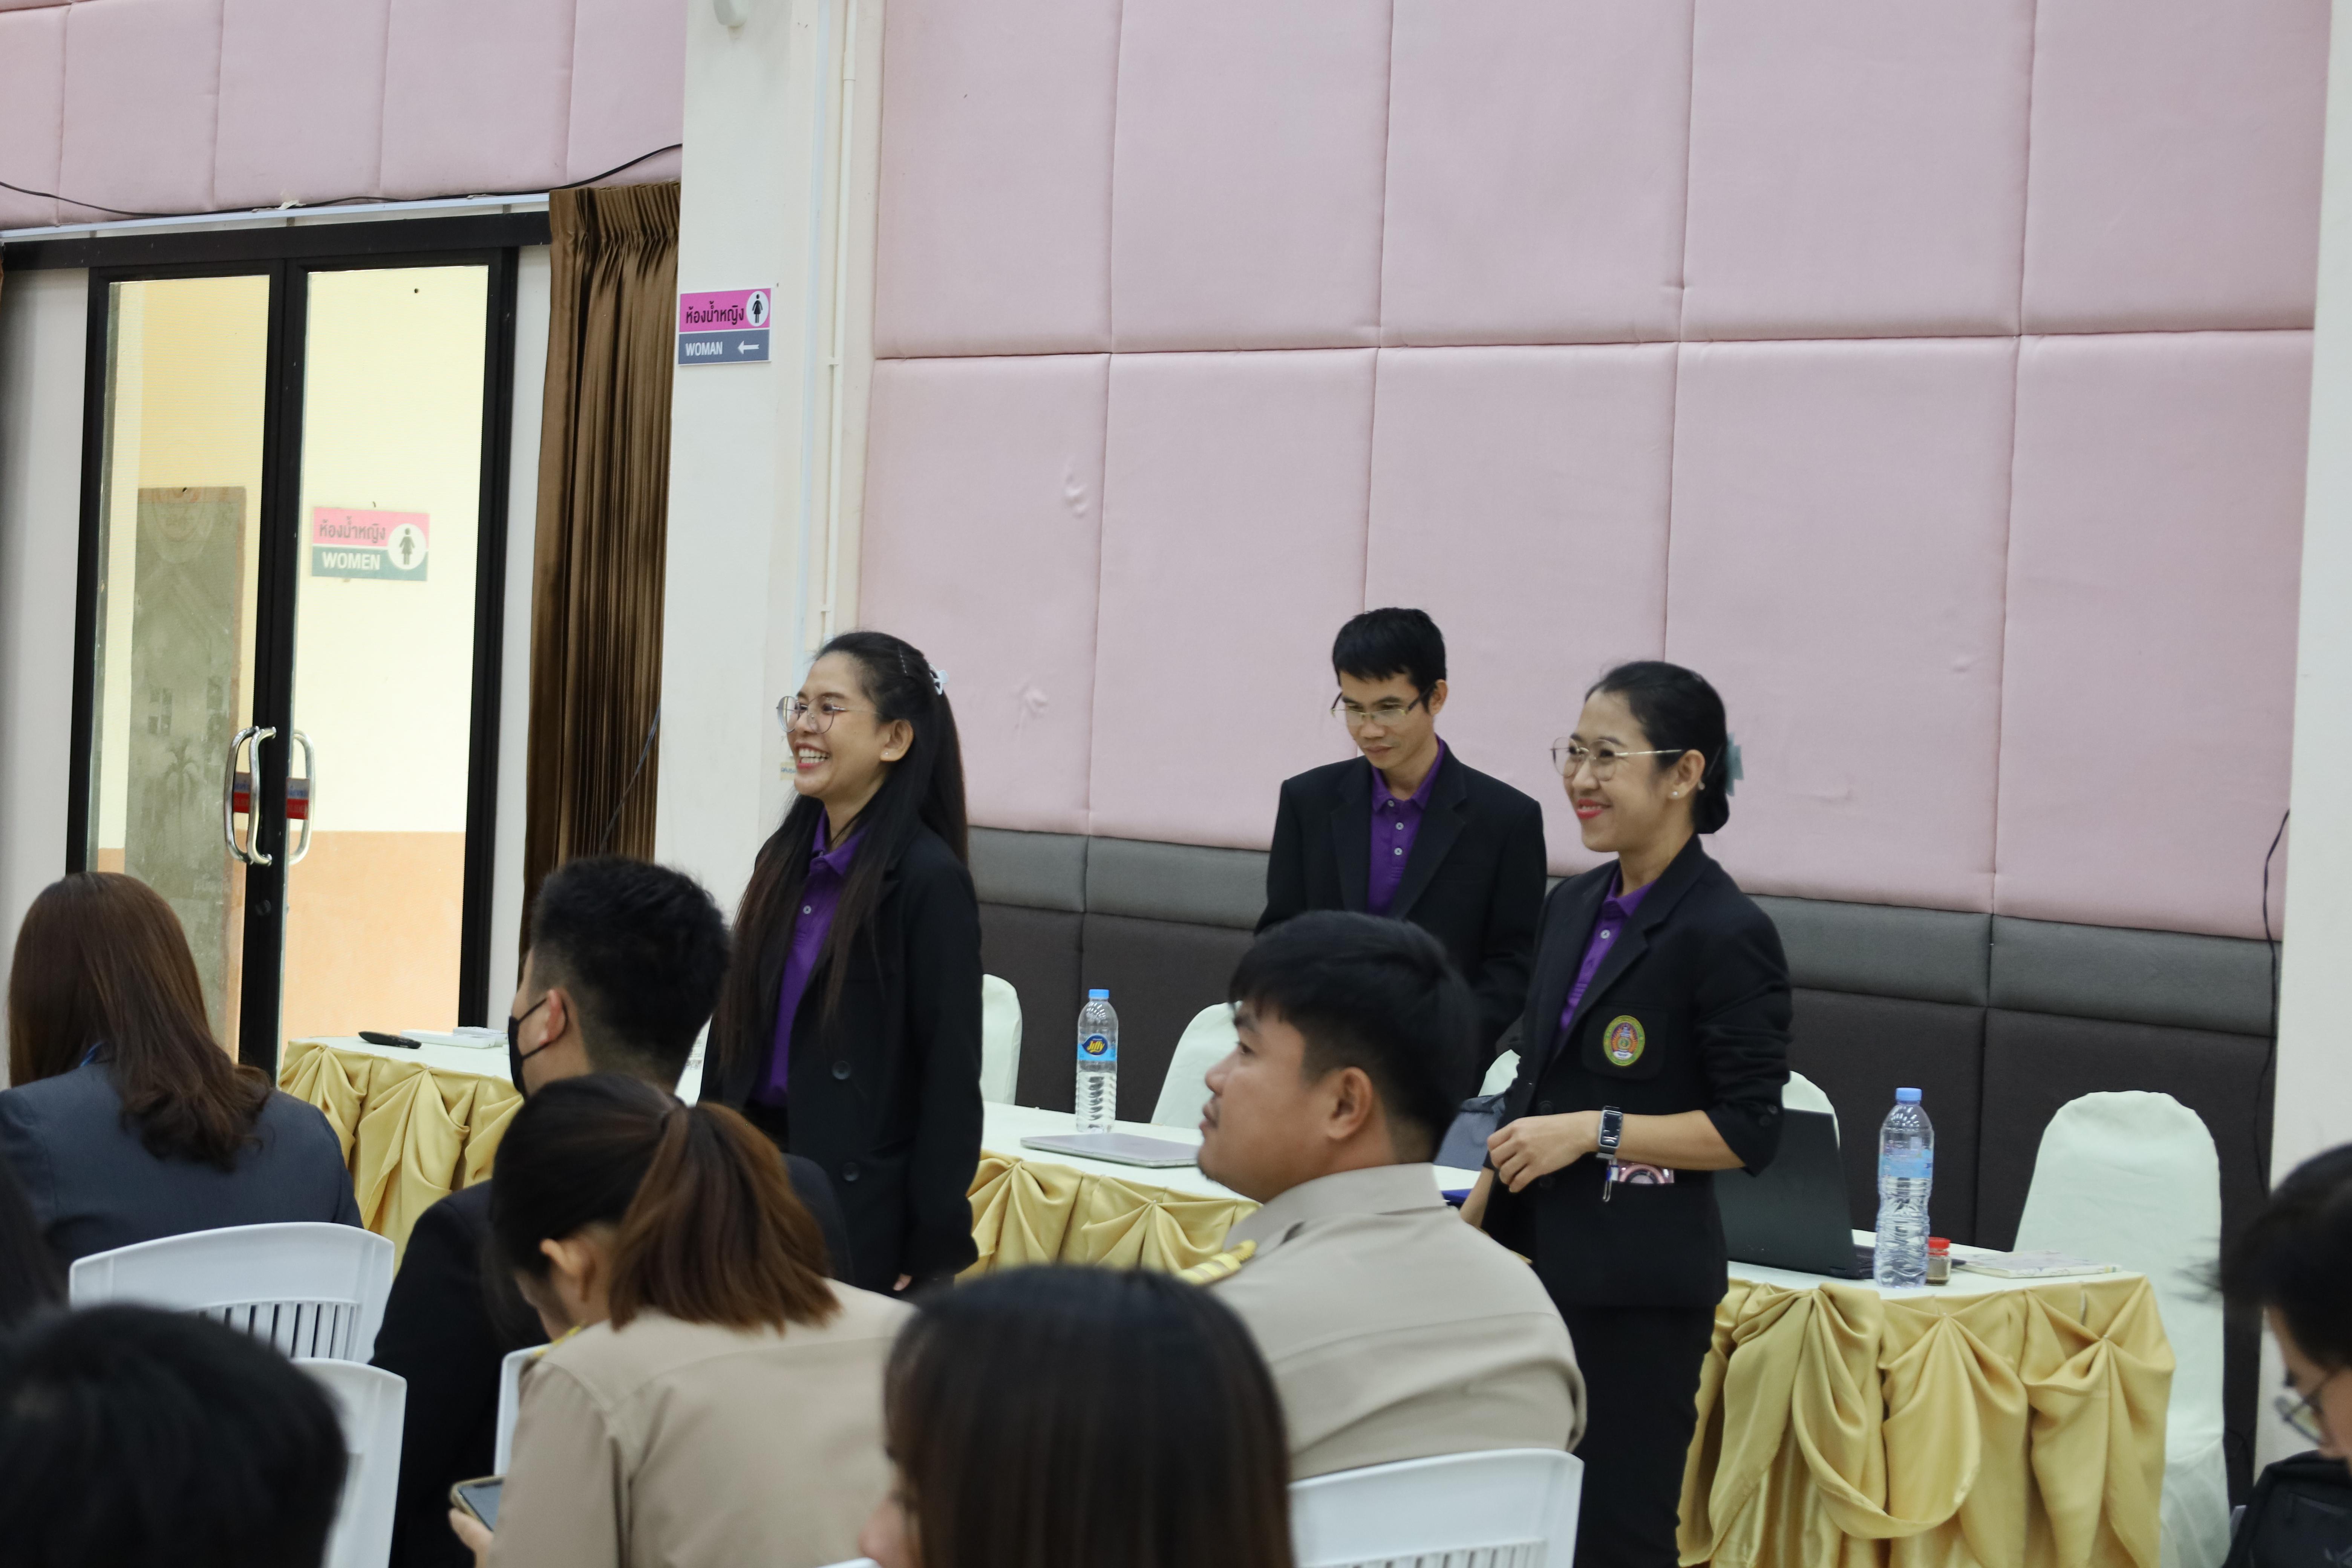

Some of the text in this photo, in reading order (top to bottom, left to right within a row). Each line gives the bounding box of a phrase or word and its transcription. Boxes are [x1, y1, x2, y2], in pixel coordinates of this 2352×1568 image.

[686, 301, 744, 325] ห้องน้ำหญิง
[685, 341, 723, 356] WOMAN
[319, 515, 386, 544] ห้องน้ำหญิง
[322, 551, 381, 570] WOMEN
